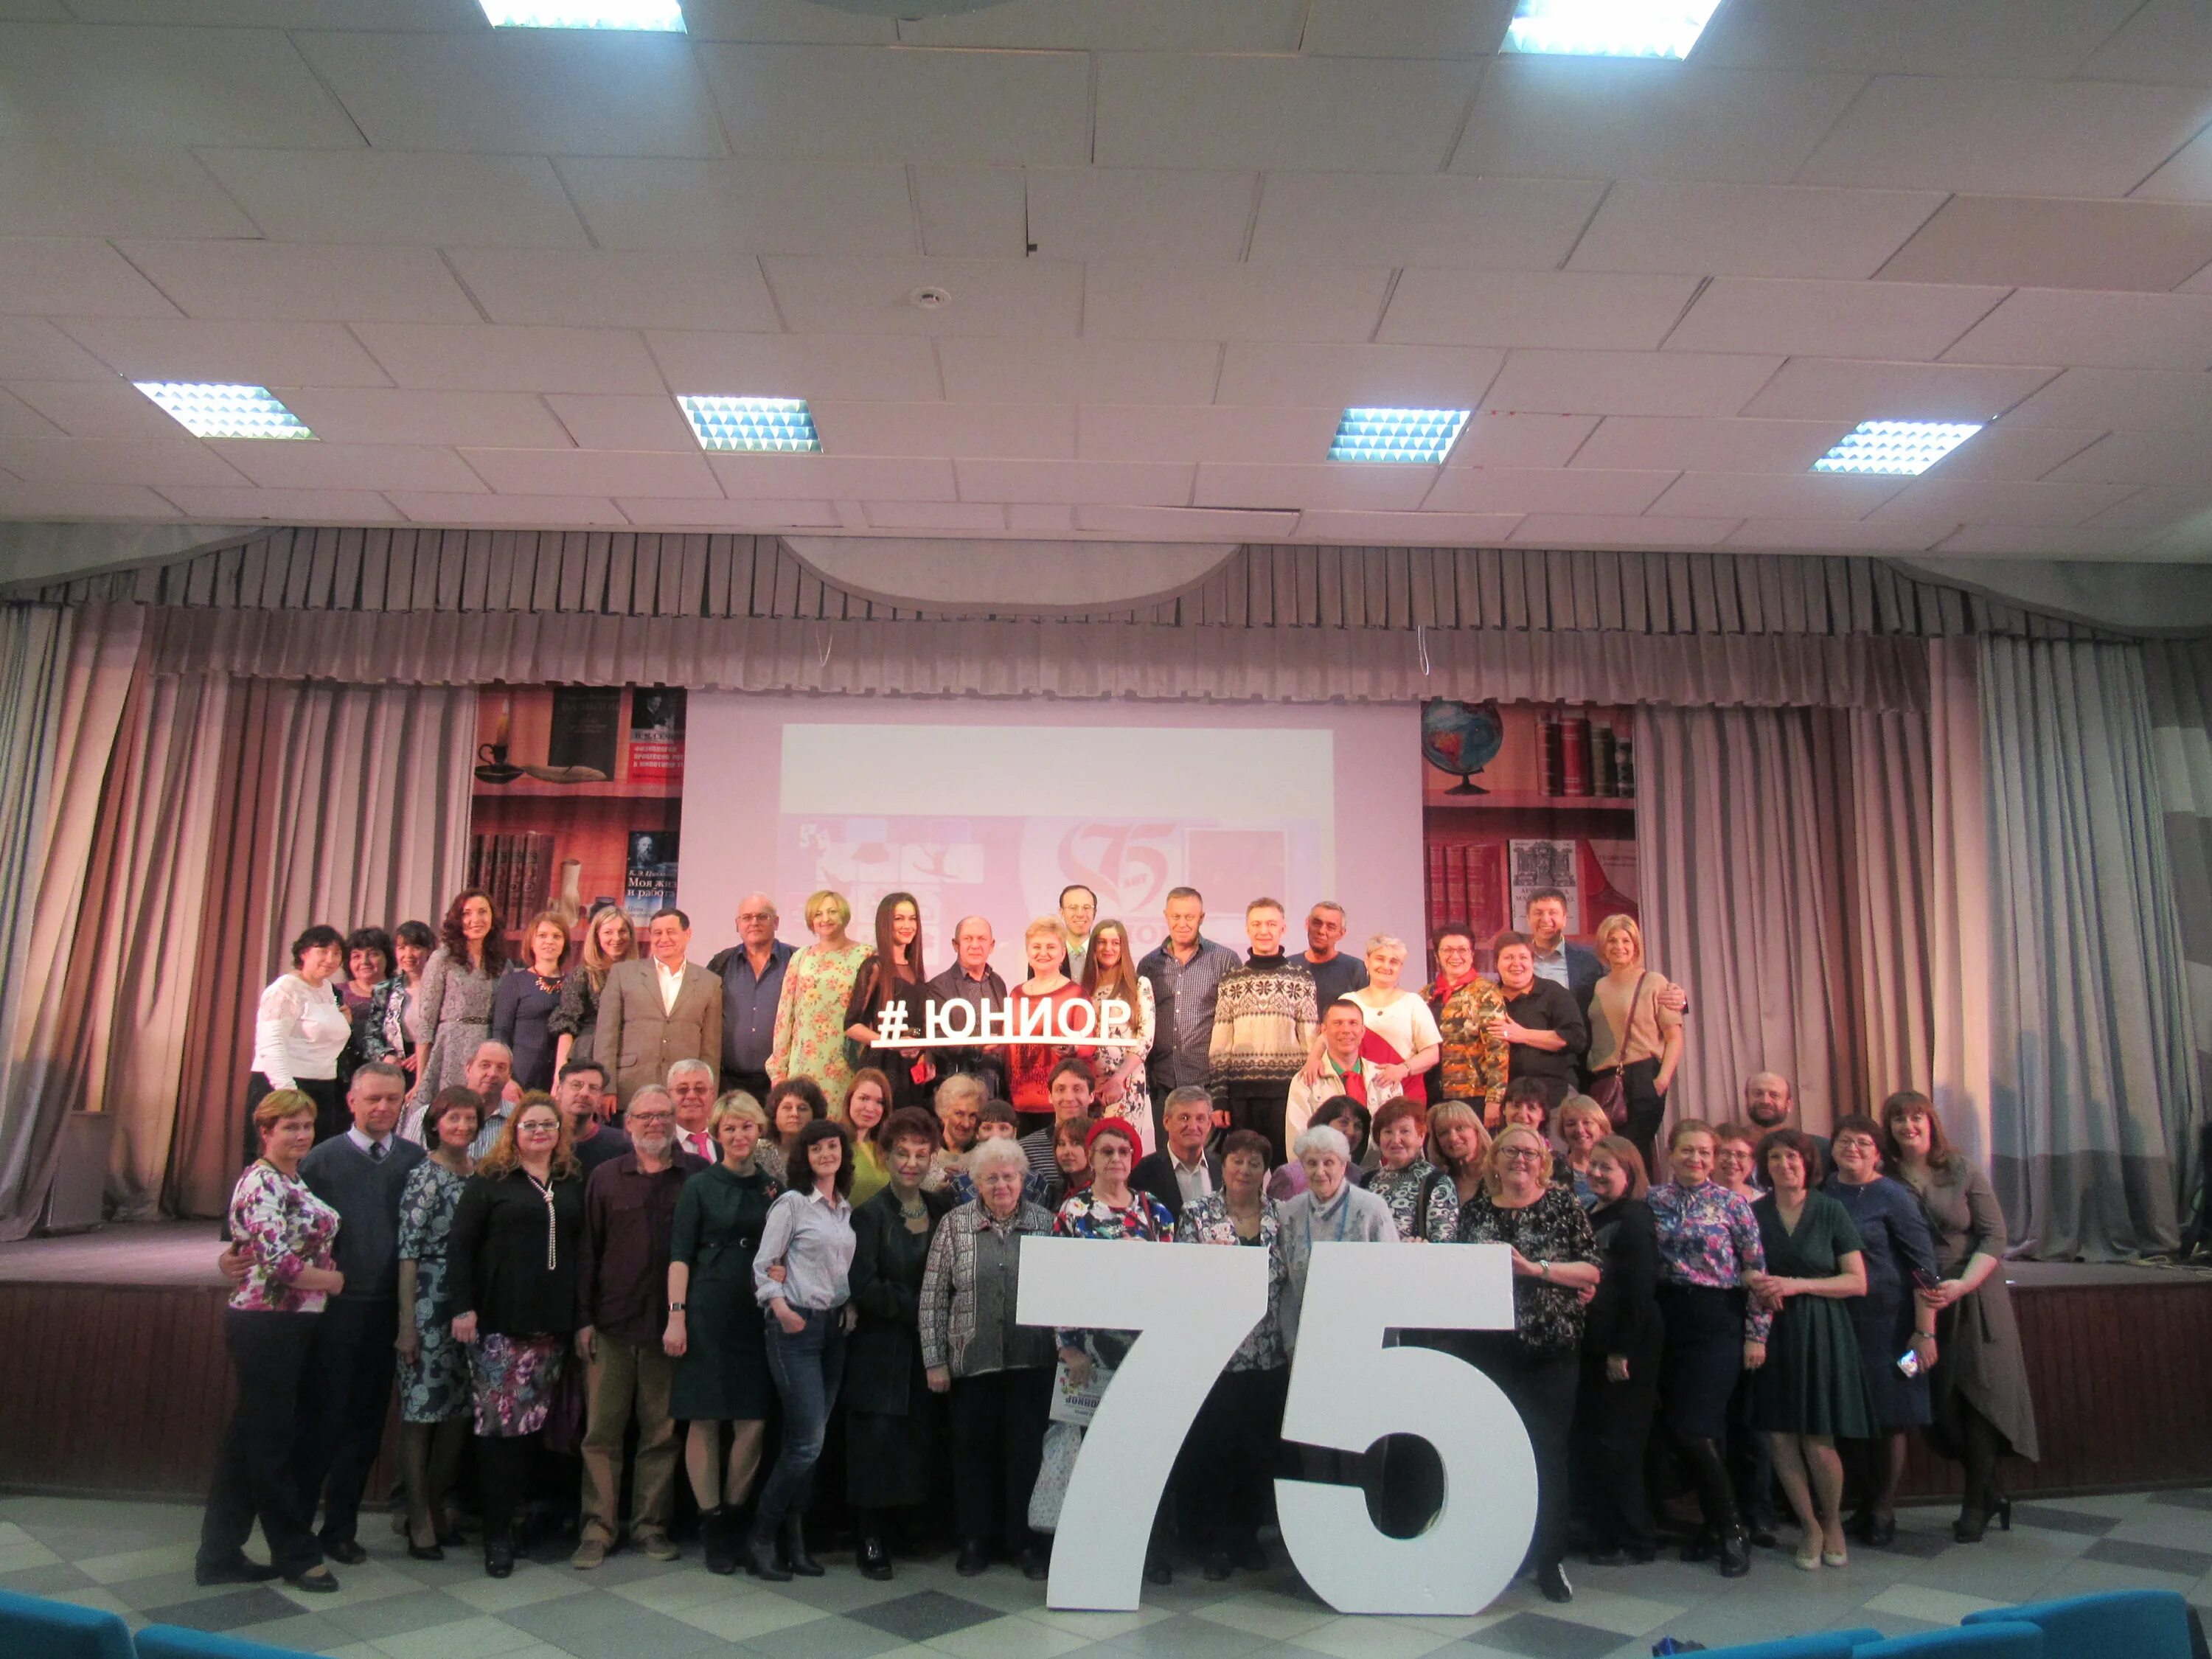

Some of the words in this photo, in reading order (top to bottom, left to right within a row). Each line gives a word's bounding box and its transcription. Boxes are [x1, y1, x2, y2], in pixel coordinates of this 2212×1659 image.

[629, 877, 653, 887] Моя
[1079, 821, 1178, 913] 75
[877, 1000, 908, 1040] #
[925, 997, 1131, 1039] ЮНИОР
[1016, 1235, 1539, 1616] 75
